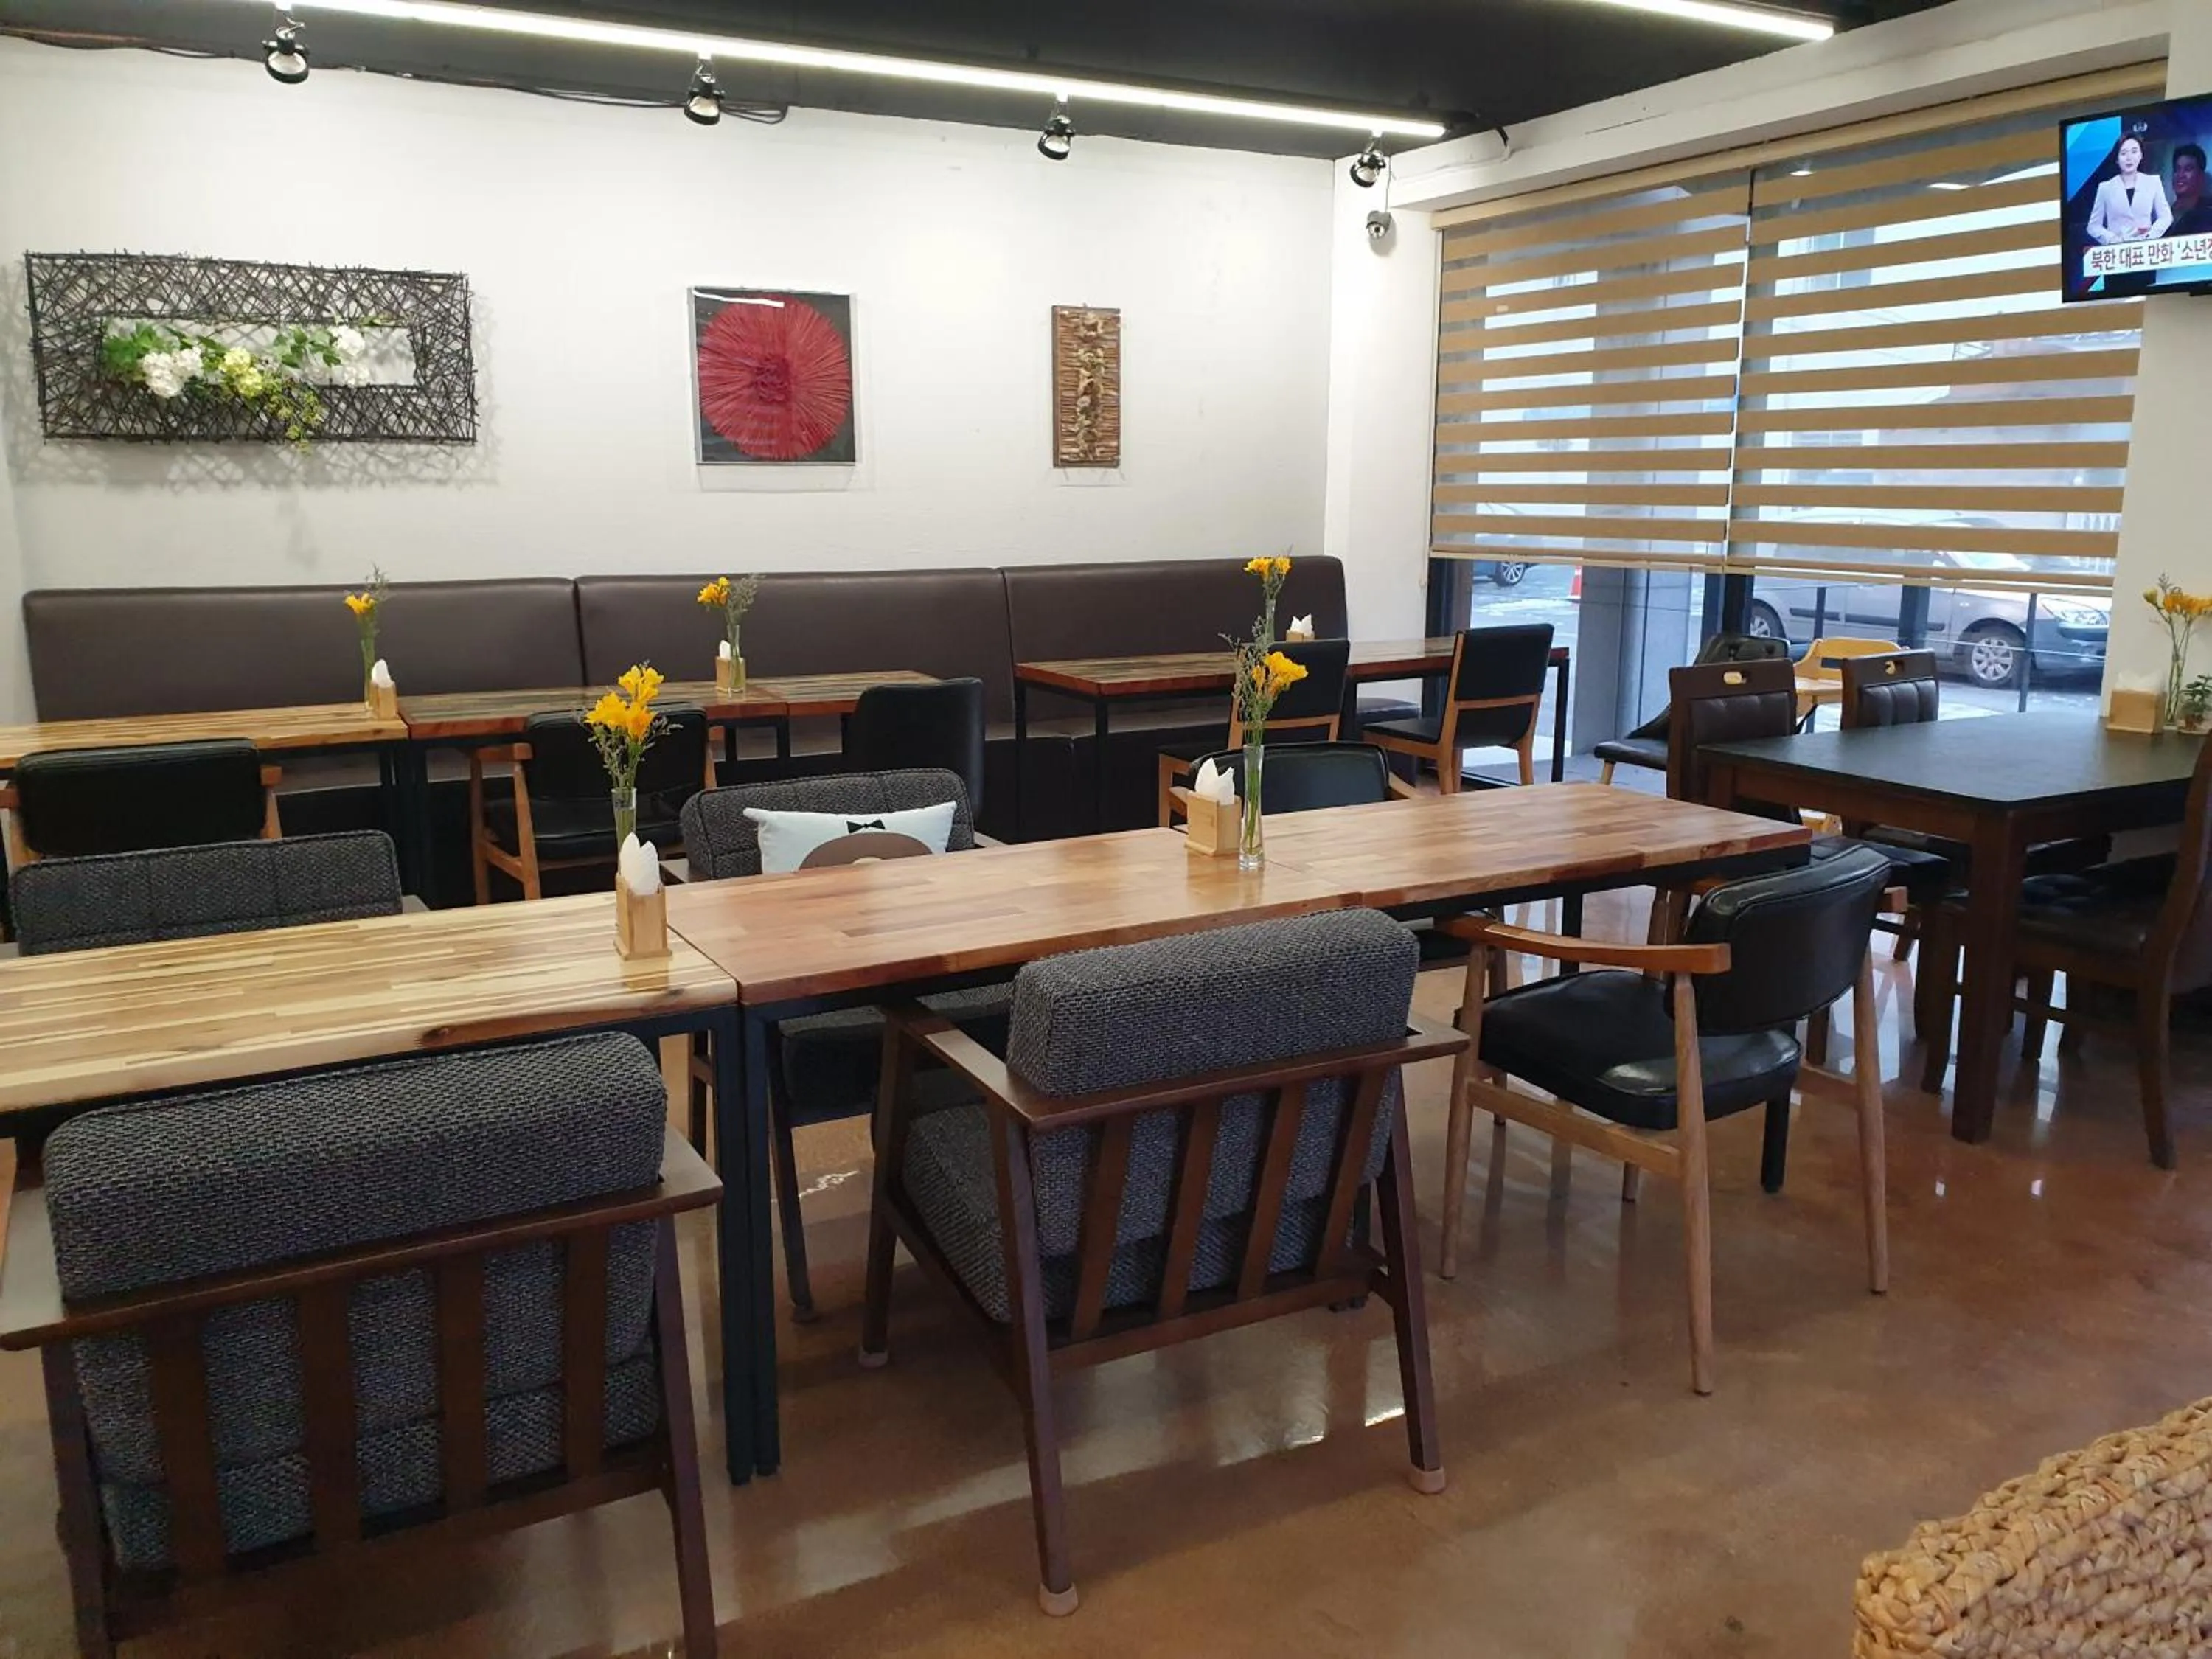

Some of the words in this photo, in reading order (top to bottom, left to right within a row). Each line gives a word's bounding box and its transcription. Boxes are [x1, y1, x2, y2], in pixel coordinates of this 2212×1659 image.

[2091, 248, 2115, 271] 북한
[2120, 246, 2144, 268] 대표
[2148, 242, 2174, 265] 만화
